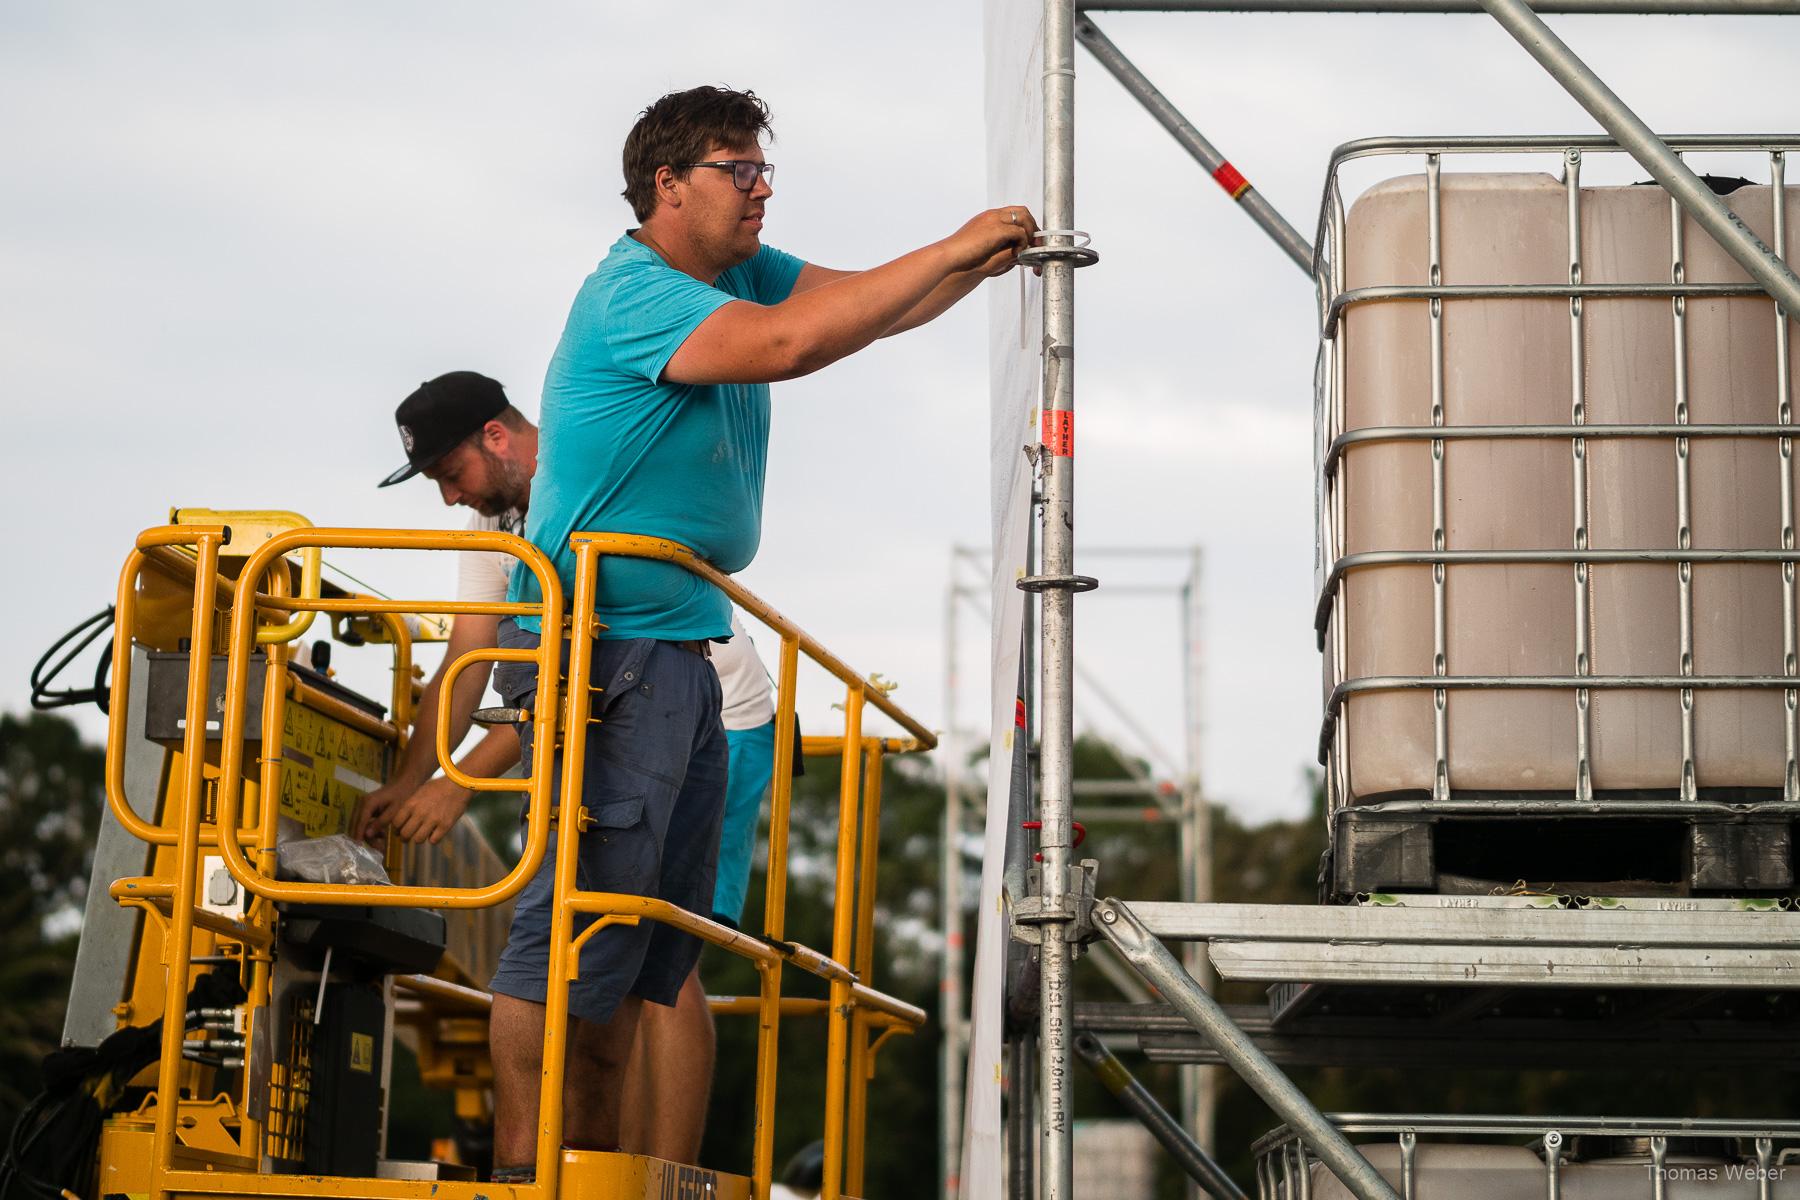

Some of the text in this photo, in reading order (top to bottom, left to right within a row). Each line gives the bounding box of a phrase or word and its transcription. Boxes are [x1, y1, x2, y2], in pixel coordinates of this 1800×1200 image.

[1439, 898, 1479, 908] LAYHER
[1048, 980, 1065, 1134] DSL Stiel 2.0m mRV
